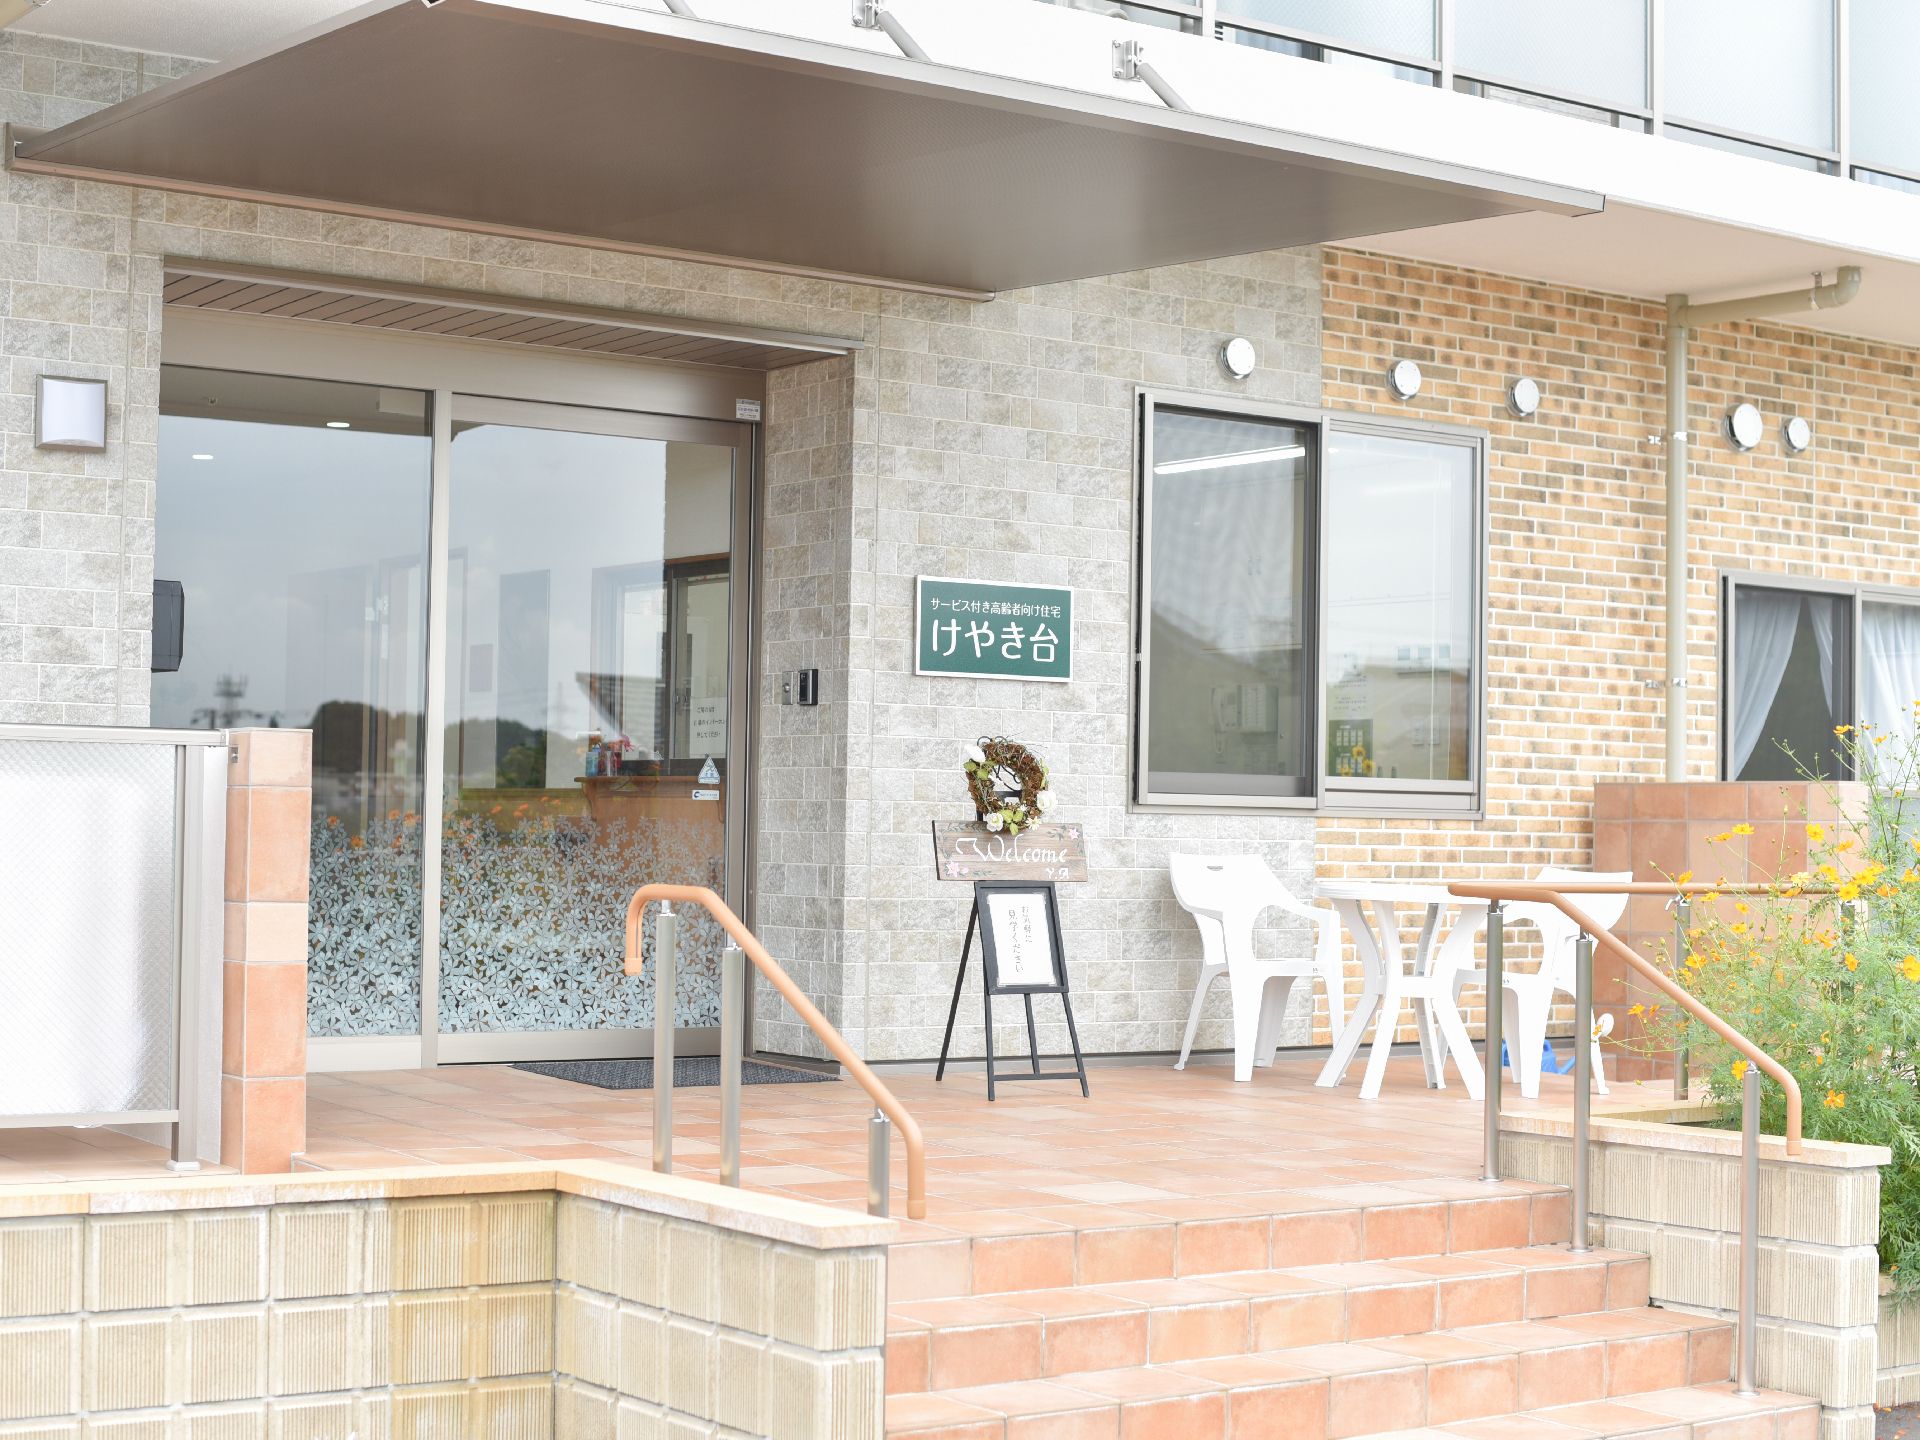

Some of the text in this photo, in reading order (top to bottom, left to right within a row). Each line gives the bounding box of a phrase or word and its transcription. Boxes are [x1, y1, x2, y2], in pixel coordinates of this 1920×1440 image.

[930, 597, 1061, 618] サービス付き高齢者向け住宅
[932, 618, 1059, 663] けやき台
[955, 833, 1068, 863] Welcome
